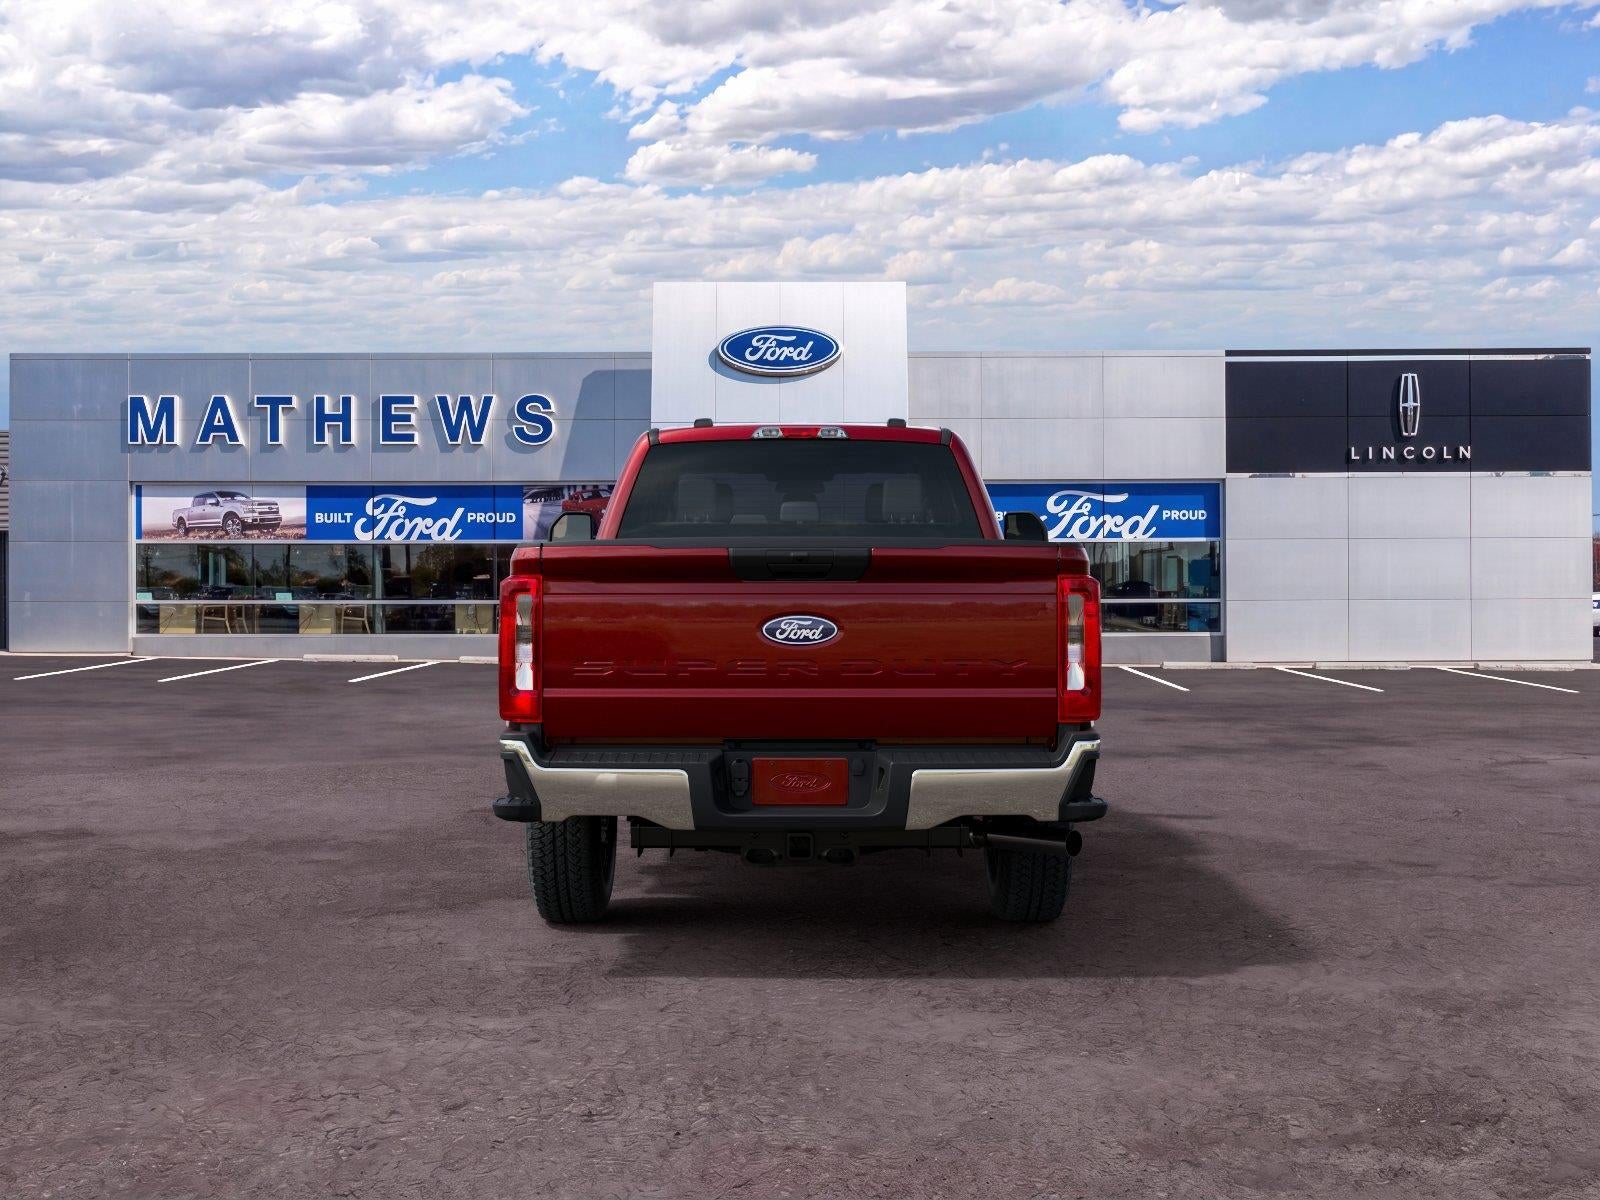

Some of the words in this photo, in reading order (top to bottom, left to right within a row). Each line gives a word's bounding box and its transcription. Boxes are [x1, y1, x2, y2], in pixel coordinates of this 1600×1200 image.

[744, 334, 814, 361] Ford
[127, 394, 556, 446] MATHEWS
[1351, 446, 1471, 460] LINCOLN
[315, 512, 353, 524] BUILT
[354, 494, 465, 541] Ford
[467, 512, 516, 524] PROUD
[1042, 490, 1160, 540] Ford
[1162, 509, 1207, 521] PROUD
[775, 619, 824, 640] Ford
[572, 658, 819, 676] SUPER
[840, 658, 1029, 676] DUTY
